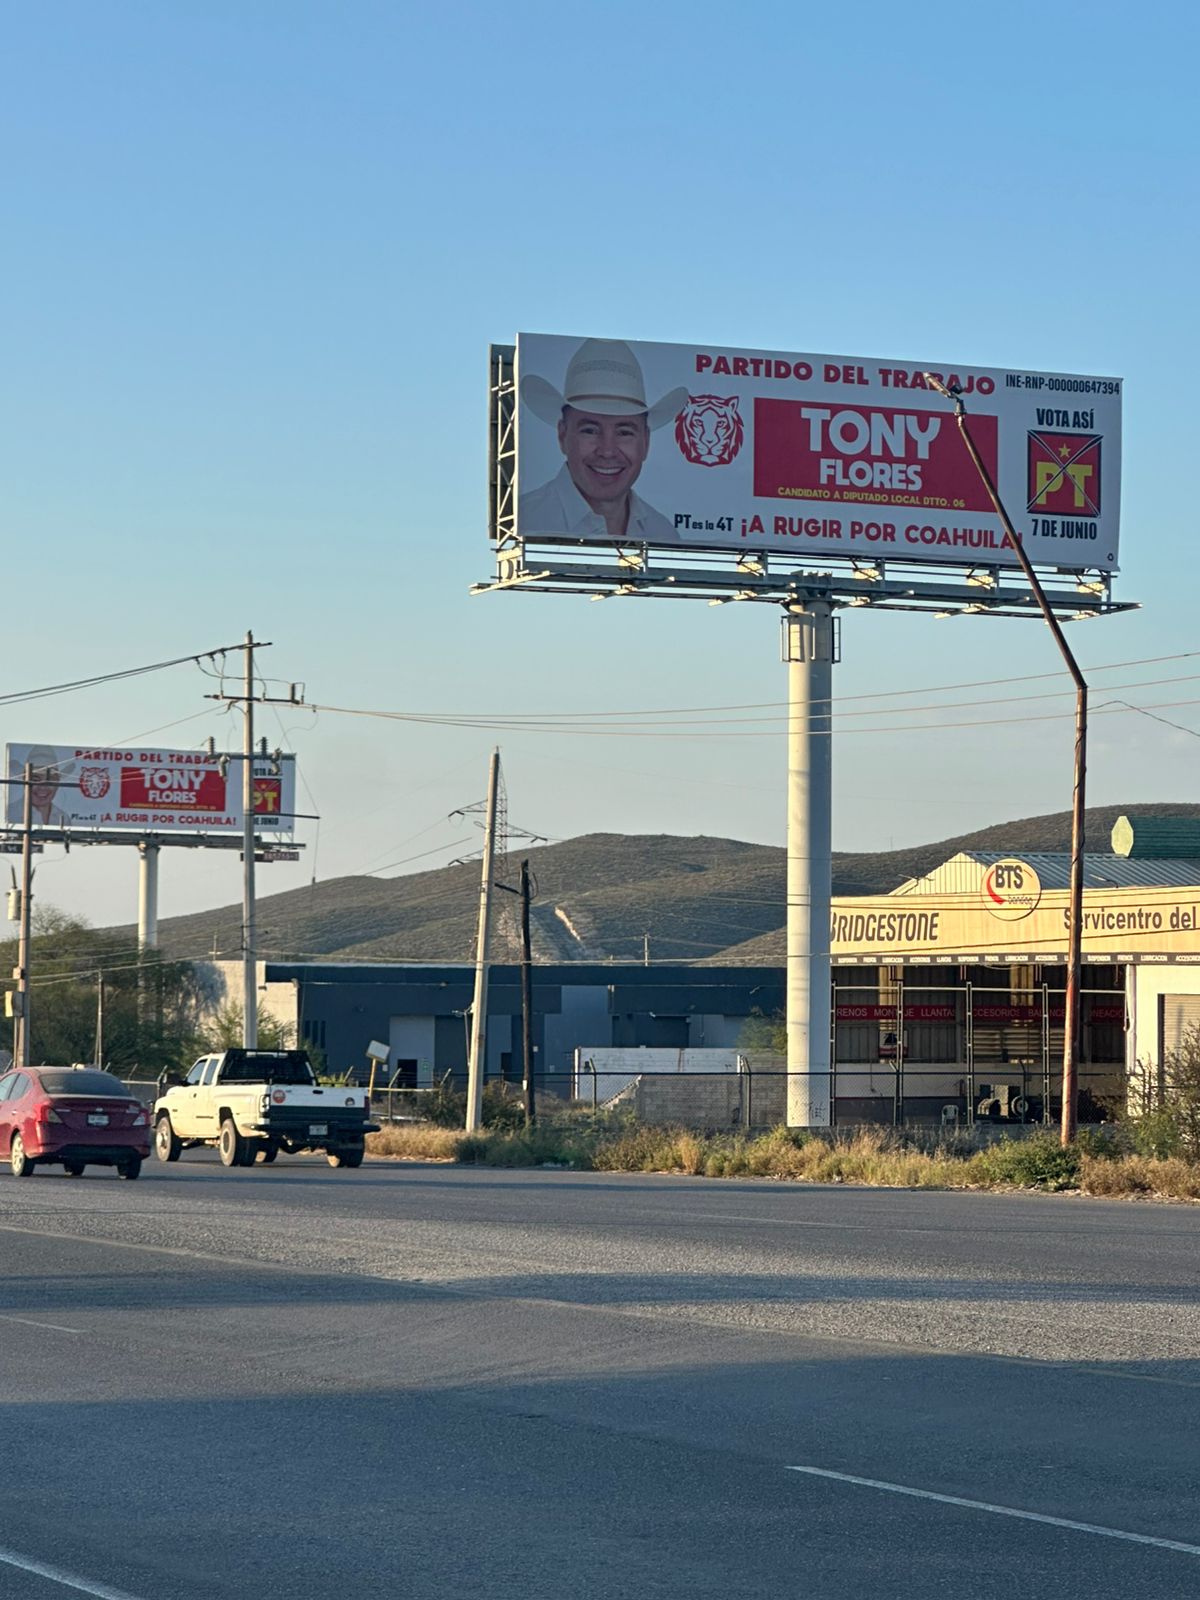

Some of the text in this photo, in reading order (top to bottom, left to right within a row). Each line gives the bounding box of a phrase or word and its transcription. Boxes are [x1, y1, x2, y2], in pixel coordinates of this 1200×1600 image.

[696, 354, 995, 396] PARTIDO DEL TRABAJO
[1036, 408, 1094, 430] VOTA ASÍ
[801, 407, 941, 460] TONY
[820, 458, 923, 491] FLORES
[1036, 461, 1093, 508] PT
[778, 486, 965, 508] CANDIDATO A DIPUTADO LOCAL DTTO. 06
[674, 513, 734, 532] PT es la 4T
[741, 515, 764, 537] ¡A
[774, 516, 842, 539] RUGIR
[851, 521, 896, 542] POR
[1032, 519, 1097, 540] 7 DE JUNIO
[75, 750, 217, 765] PARTIDO DEL TRABA
[141, 768, 205, 790] TONY
[148, 790, 196, 803] FLORES
[116, 813, 149, 823] RUGIR
[153, 815, 174, 824] POR
[178, 816, 236, 826] COAHUILA!
[995, 865, 1023, 889] BTS
[1063, 906, 1196, 929] Srvicentro del
[836, 1007, 868, 1017] RENOS
[873, 1007, 914, 1017] MONTJE
[973, 1008, 1021, 1018] CCESORIOS
[1028, 1008, 1066, 1018] BALNCE
